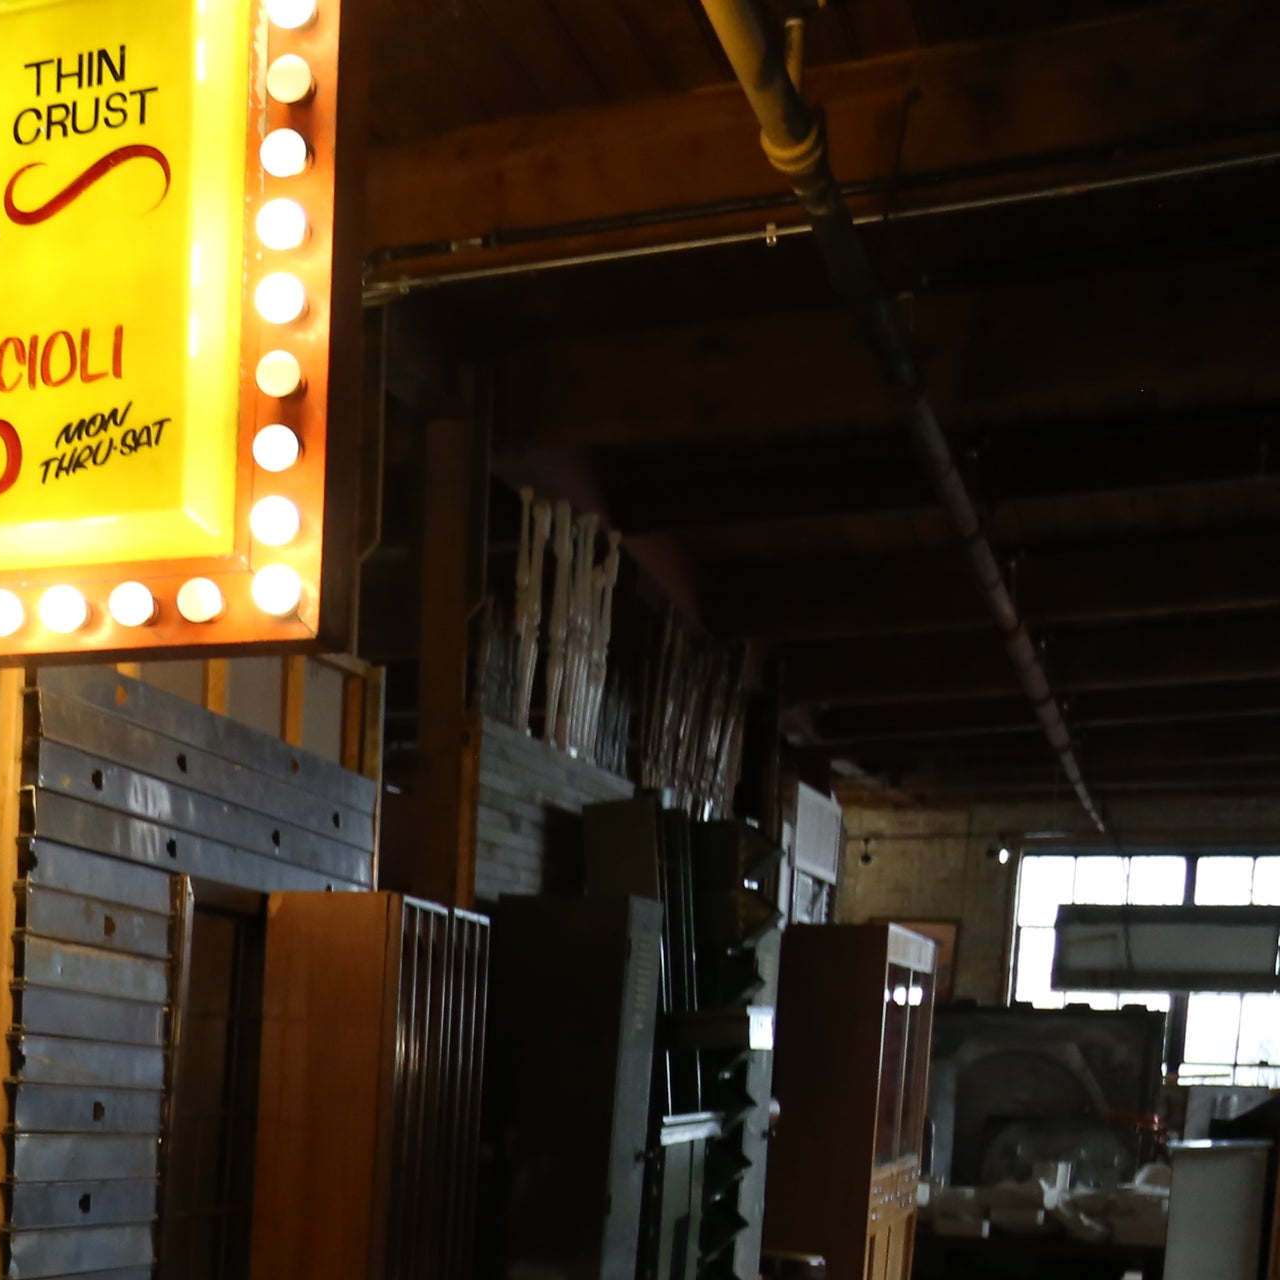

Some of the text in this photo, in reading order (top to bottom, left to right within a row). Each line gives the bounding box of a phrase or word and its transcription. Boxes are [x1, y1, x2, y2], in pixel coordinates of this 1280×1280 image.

[23, 44, 126, 97] THIN
[12, 86, 159, 146] CRUST
[54, 400, 133, 449] MON
